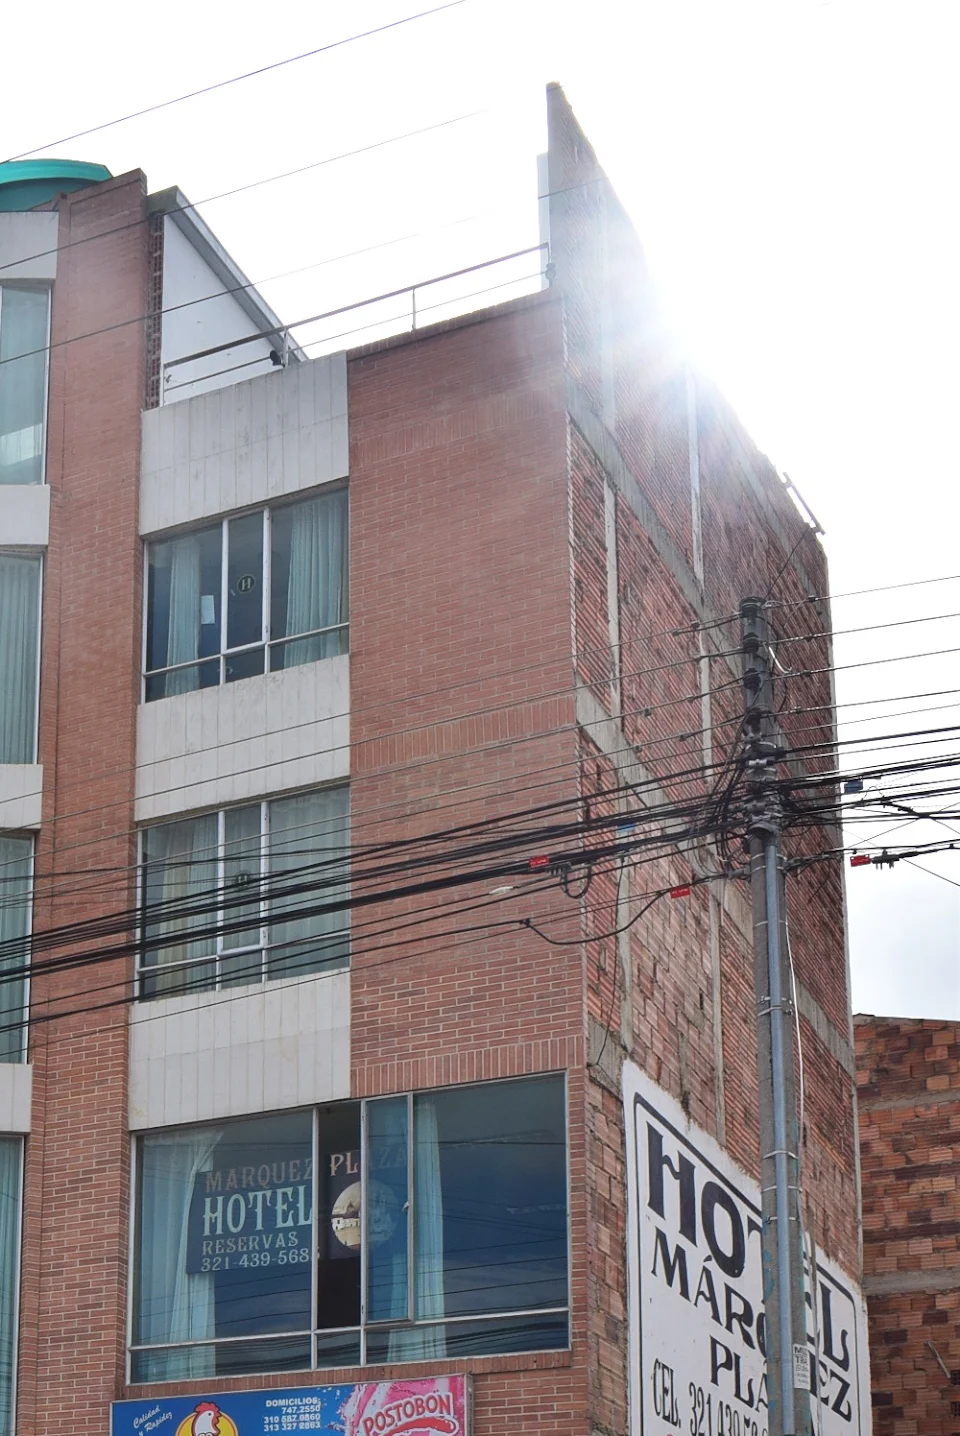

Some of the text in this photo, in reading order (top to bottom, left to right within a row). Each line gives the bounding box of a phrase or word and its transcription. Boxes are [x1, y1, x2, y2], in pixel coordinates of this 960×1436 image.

[205, 1159, 313, 1193] MARQUEZ
[202, 1184, 313, 1237] HOTEL
[202, 1231, 299, 1256] RESERVAS
[651, 1225, 852, 1423] MÁREZ
[266, 1397, 321, 1408] DOMICILIOS:
[133, 1404, 161, 1429] Calidad
[263, 1415, 280, 1424] 310
[263, 1423, 280, 1432] 313
